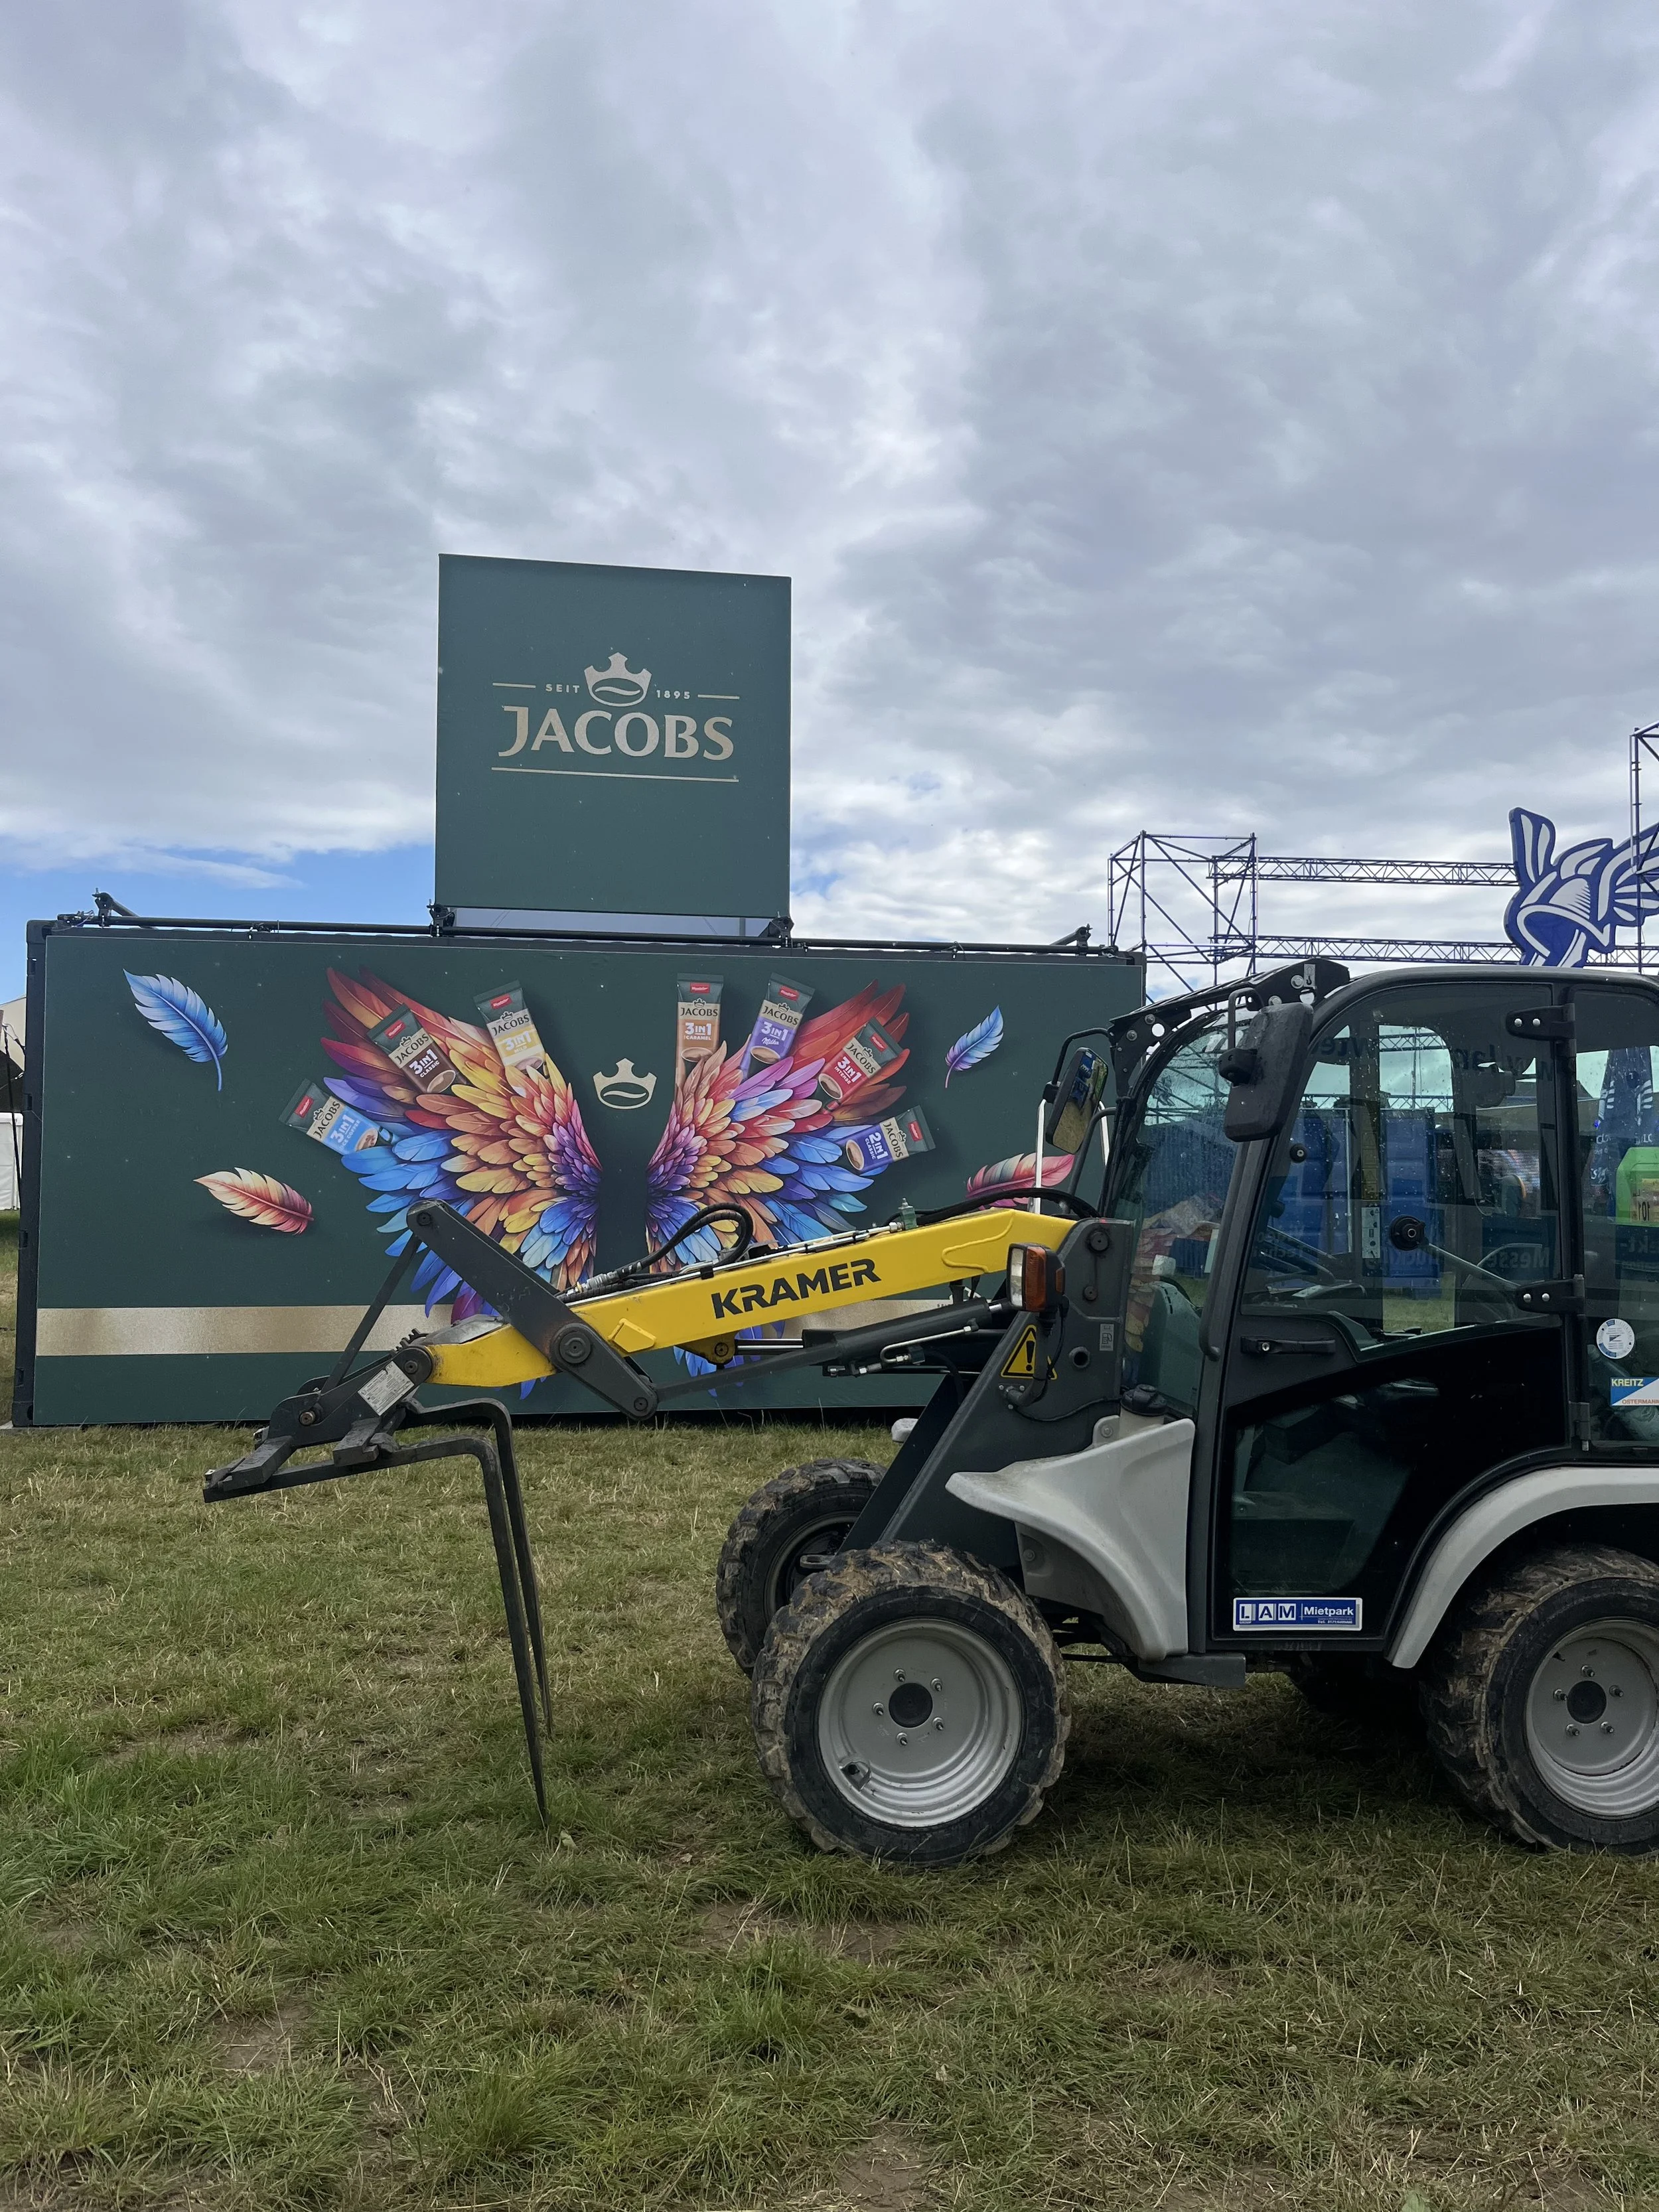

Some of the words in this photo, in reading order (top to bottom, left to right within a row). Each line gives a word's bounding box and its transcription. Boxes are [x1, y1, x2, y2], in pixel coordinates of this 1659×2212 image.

[545, 684, 580, 694] SEIT
[656, 690, 691, 700] 1895
[498, 705, 734, 761] JACOBS
[680, 1007, 718, 1017] JACOBS
[762, 1005, 800, 1025] JACOBS
[492, 1014, 530, 1036] JACOBS
[395, 1033, 429, 1065] JACOBS
[761, 1037, 779, 1045] Milka
[420, 1060, 440, 1078] CLASSIC
[846, 1043, 876, 1074] JACOBS
[834, 1066, 851, 1084] INTENSE
[313, 1101, 340, 1139] JACOBS
[865, 1138, 876, 1159] CLASSIC
[883, 1122, 904, 1158] JACOBS
[711, 1258, 882, 1319] KRAMER
[1304, 1606, 1354, 1617] Mietpark
